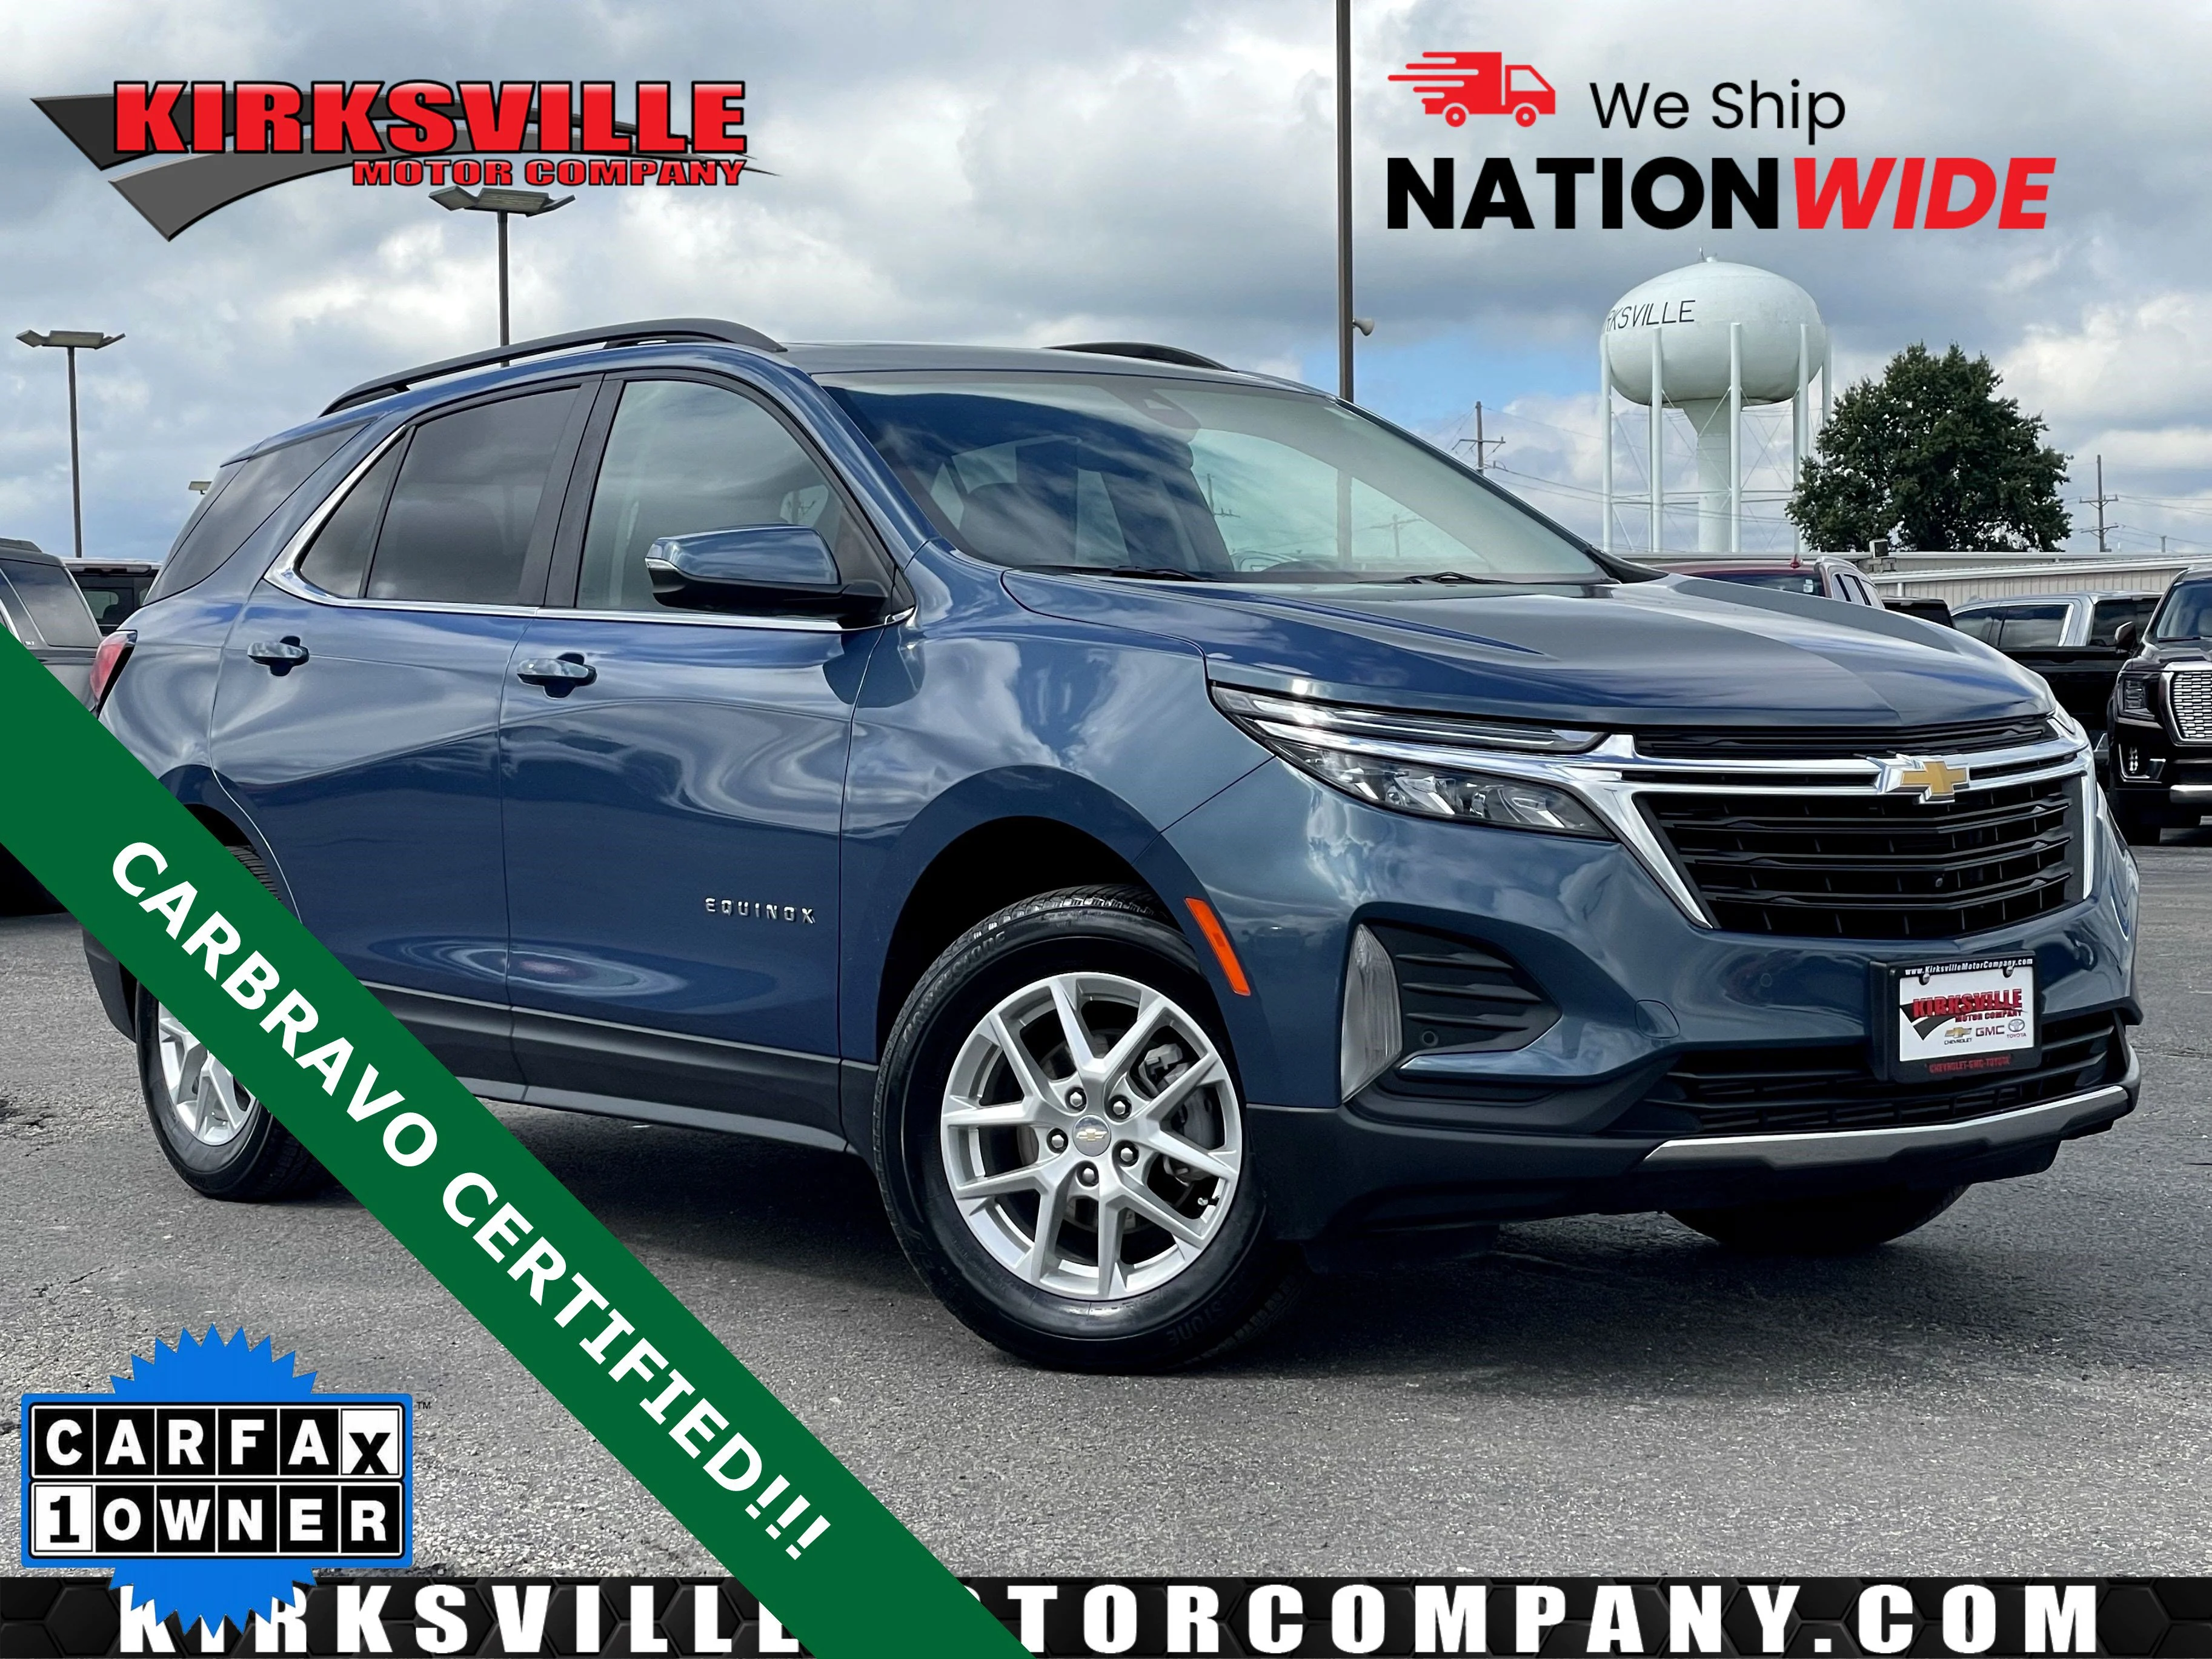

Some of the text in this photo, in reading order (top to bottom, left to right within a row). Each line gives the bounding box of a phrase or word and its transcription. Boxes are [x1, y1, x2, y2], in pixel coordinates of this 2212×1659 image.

[1606, 299, 1695, 331] RKSVILLE
[705, 898, 815, 923] EQUINOX
[1905, 958, 2033, 975] www.KirksvilleMotorCompany.com
[1912, 989, 2022, 1018] KIRKSVILLE
[1955, 1009, 2022, 1023] MOTOR COMPANY
[1975, 1025, 2005, 1037] GMC
